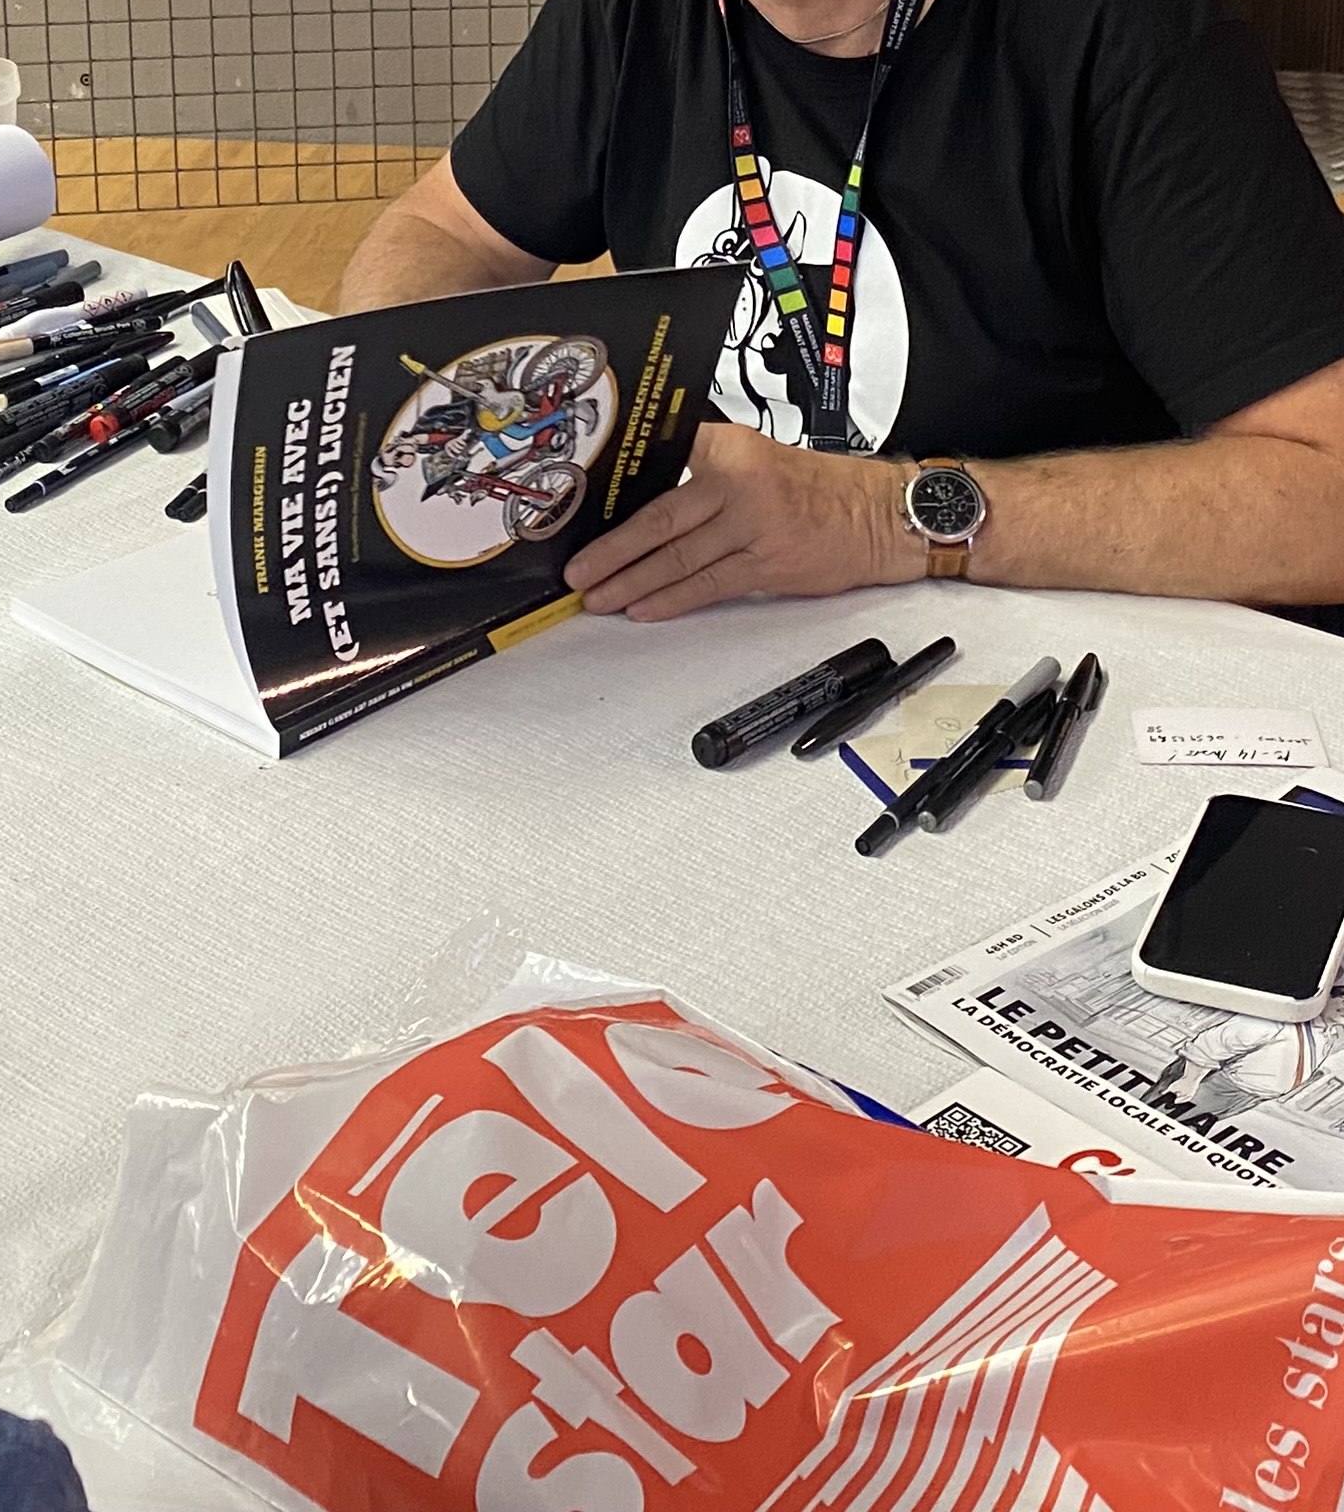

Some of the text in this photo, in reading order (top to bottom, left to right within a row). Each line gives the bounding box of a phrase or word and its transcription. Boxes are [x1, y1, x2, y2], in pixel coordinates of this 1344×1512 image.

[318, 345, 356, 465] LUCIEN
[604, 448, 630, 520] CINQUANTE
[624, 365, 655, 450] TRUCULENTES
[640, 421, 652, 437] ET
[645, 402, 659, 421] DE
[253, 446, 269, 594] FRANK MARGERIN
[281, 399, 312, 625] MA VIE AVEC
[627, 457, 641, 476] DE
[315, 471, 345, 591] SANS!)
[323, 601, 360, 662] (ET
[985, 933, 1023, 955] 48H BD
[1045, 870, 1148, 925] LES GALONS DE LA BD
[951, 997, 1280, 1189] LA DÉMOCRATIE LOCALE AU QUOT
[975, 986, 1295, 1176] LE PETIT MAIRE
